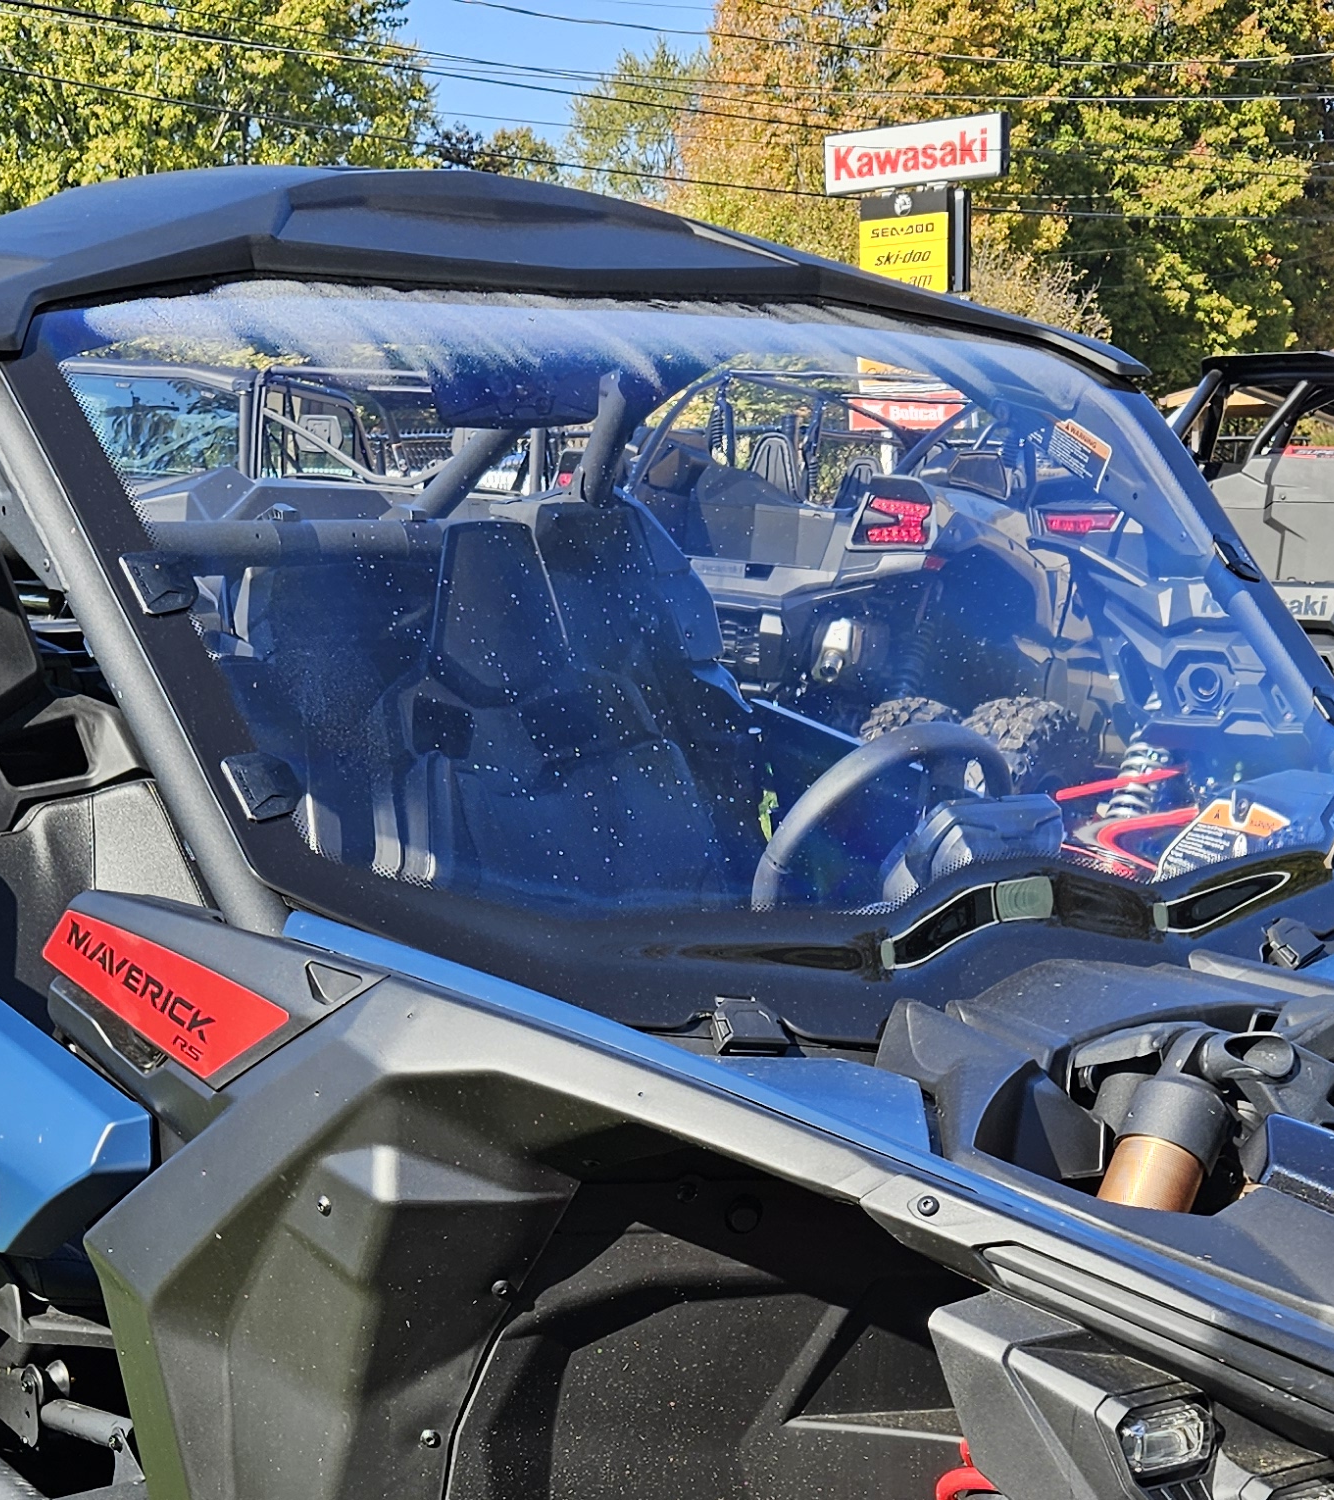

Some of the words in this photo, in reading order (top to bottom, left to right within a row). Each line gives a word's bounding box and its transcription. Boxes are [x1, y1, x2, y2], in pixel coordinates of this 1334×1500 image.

[833, 127, 988, 181] Kawasaki
[888, 405, 945, 422] Bobcat
[67, 918, 216, 1045] MAVERICK
[172, 1034, 204, 1062] RS
